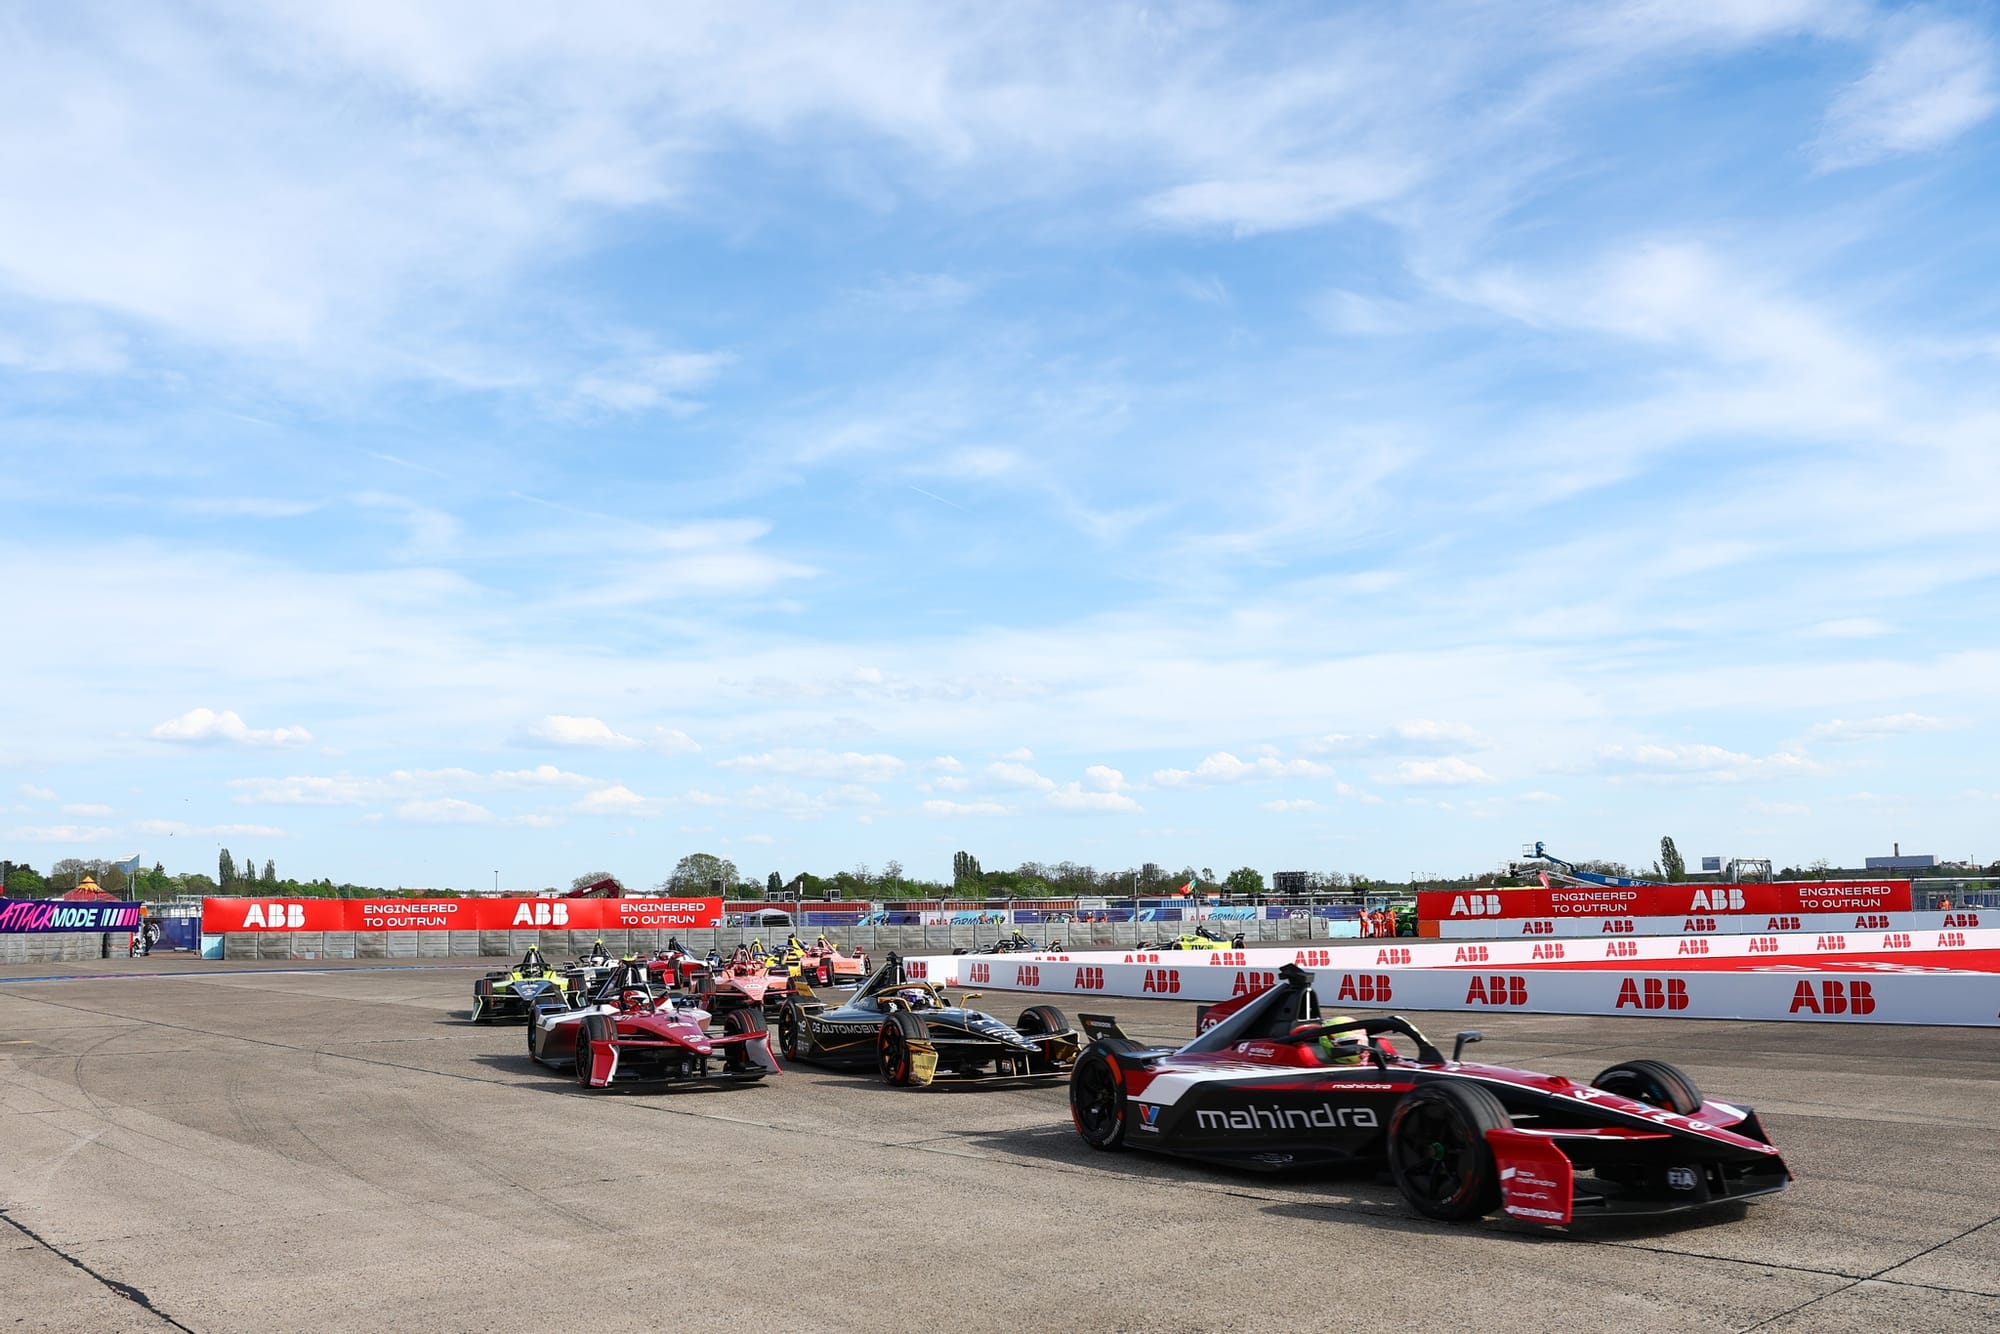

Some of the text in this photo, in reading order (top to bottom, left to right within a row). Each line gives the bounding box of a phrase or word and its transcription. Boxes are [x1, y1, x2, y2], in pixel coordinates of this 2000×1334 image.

[1552, 892, 1637, 901] ENGINEERED
[1800, 887, 1890, 896] ENGINEERED
[1450, 895, 1501, 915] ABB
[1690, 889, 1745, 910] ABB
[1800, 899, 1880, 908] TO OUTRUN
[364, 904, 457, 913] ENGINEERED
[513, 903, 568, 926] ABB
[620, 903, 705, 912] ENGINEERED
[1573, 904, 1627, 912] OUTRUN
[0, 902, 98, 931] ATTACK MODE
[243, 904, 305, 928] ABB
[364, 917, 446, 926] TO OUTRUN
[620, 915, 694, 924] TO OUTRUN
[1767, 917, 1800, 929] ABB
[1855, 916, 1889, 928] ABB
[1943, 914, 1979, 927] ABB
[1522, 922, 1553, 934] ABB
[1602, 920, 1634, 932] ABB
[1684, 919, 1716, 931] ABB
[1679, 939, 1709, 954] ABB
[1748, 937, 1778, 952] ABB
[1817, 936, 1846, 950] ABB
[1883, 934, 1911, 948] ABB
[1938, 933, 1965, 947] ABB
[1376, 949, 1411, 965] ABB
[1455, 946, 1489, 962] ABB
[1532, 944, 1564, 959] ABB
[1606, 942, 1638, 957] ABB
[1210, 952, 1246, 966] ABB
[1295, 950, 1330, 966] ABB
[906, 962, 927, 978] ABB
[970, 963, 990, 983] ABB
[1016, 966, 1040, 986] ABB
[1075, 967, 1104, 989] ABB
[1143, 969, 1180, 993] ABB
[1232, 972, 1275, 995] ABB
[1338, 974, 1392, 1002] ABB
[1465, 976, 1528, 1006] ABB
[1615, 978, 1689, 1010] ABB
[1789, 980, 1875, 1014] ABB
[1196, 1103, 1379, 1129] mahindra
